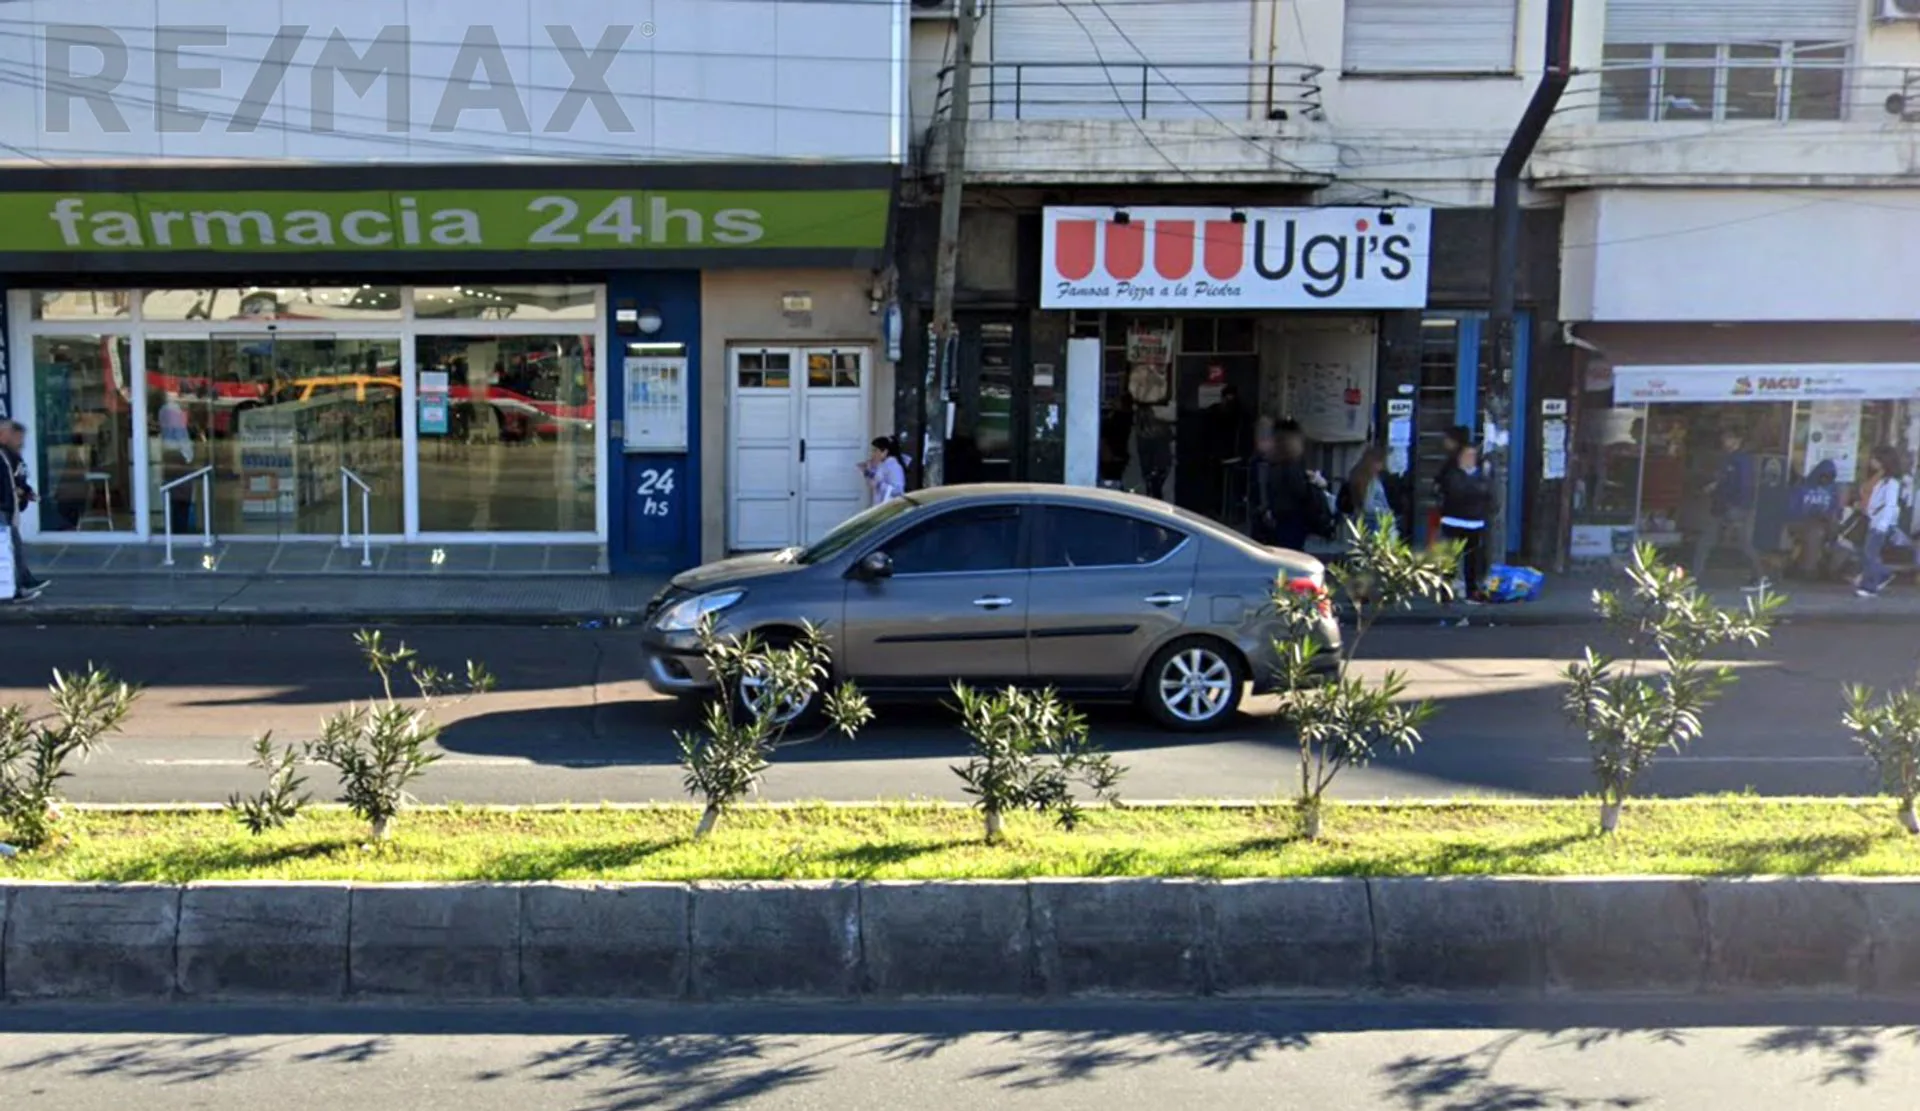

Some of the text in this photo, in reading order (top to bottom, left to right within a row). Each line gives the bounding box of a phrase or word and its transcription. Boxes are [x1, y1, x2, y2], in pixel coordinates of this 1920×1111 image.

[50, 195, 765, 247] farmacia 24hs
[1253, 218, 1412, 299] Ugi's
[1056, 280, 1242, 301] Famosa Pizza a la Piedra
[636, 468, 675, 496] 24
[643, 497, 669, 516] hs
